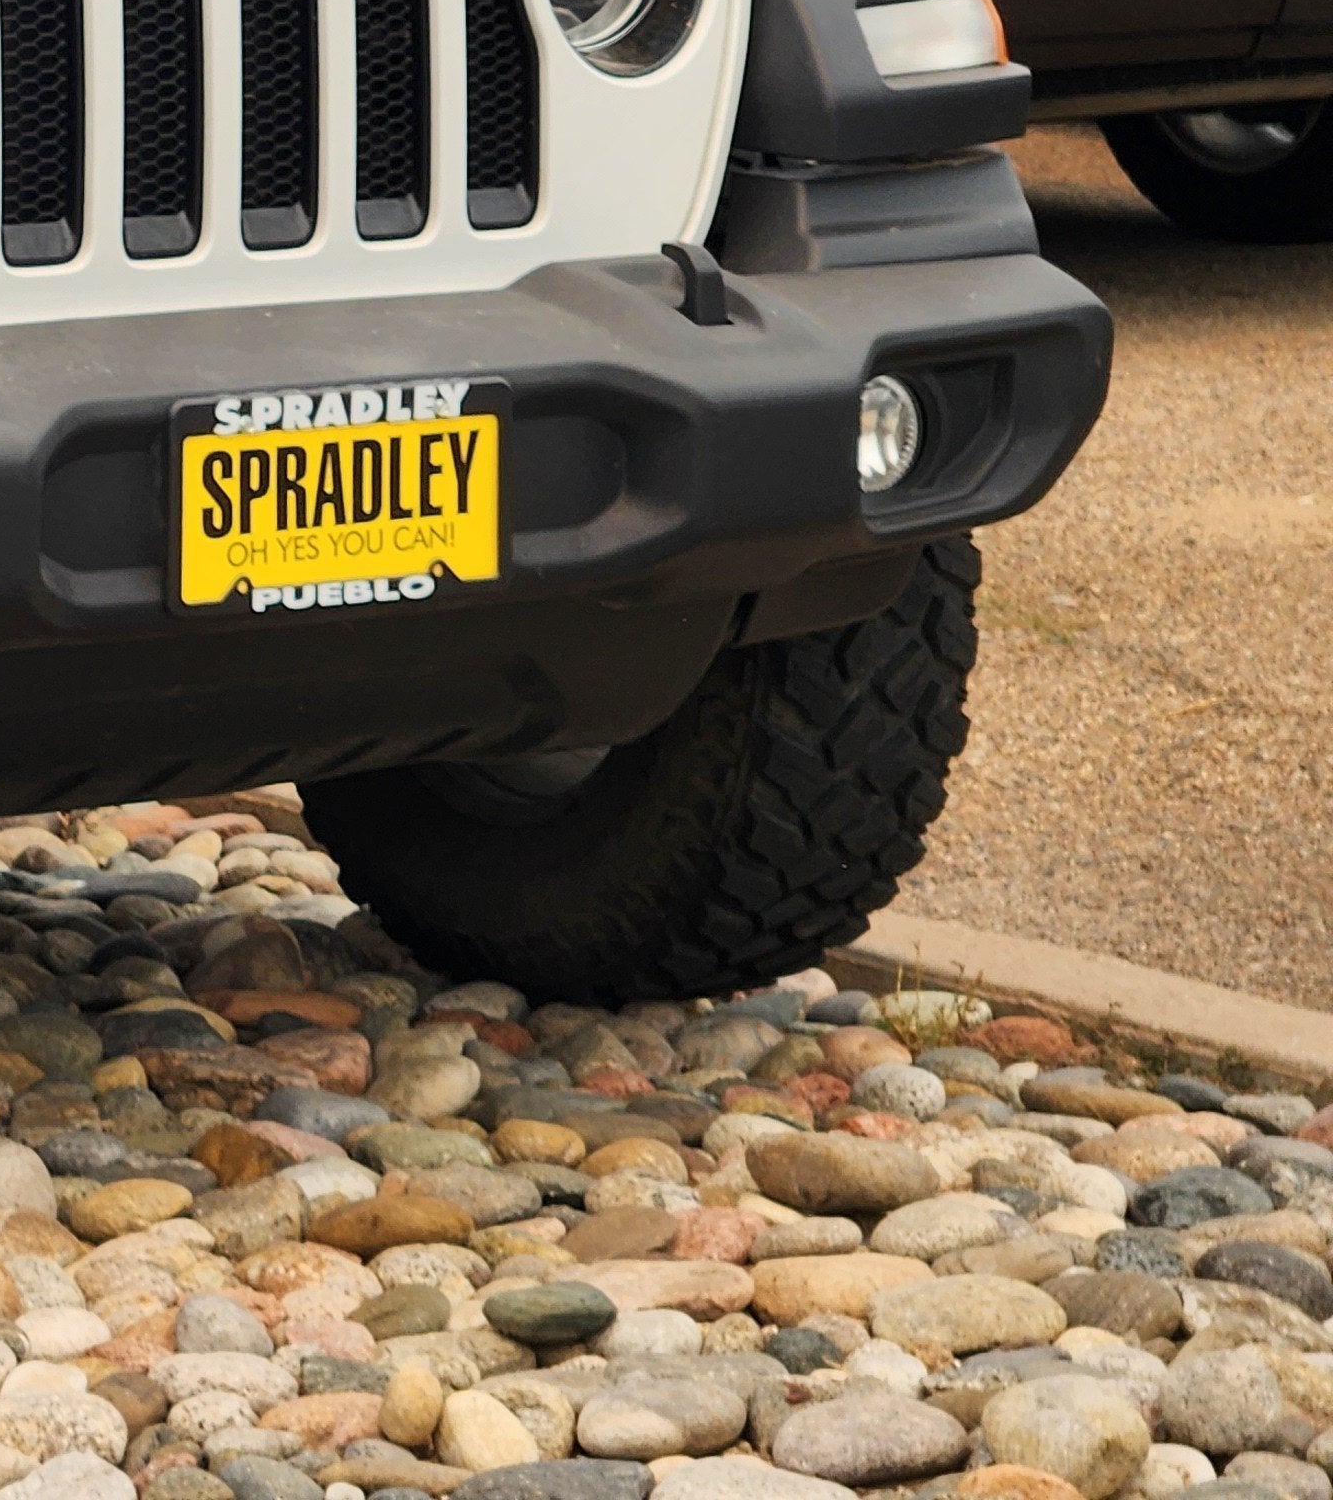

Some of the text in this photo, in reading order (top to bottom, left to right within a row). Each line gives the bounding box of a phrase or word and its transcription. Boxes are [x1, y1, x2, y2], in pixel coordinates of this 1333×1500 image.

[213, 380, 471, 436] SPRADLEY
[202, 430, 480, 539] SPRADLEY
[227, 522, 456, 568] OH YES YOU CAN!
[251, 574, 436, 614] PUEBLO
